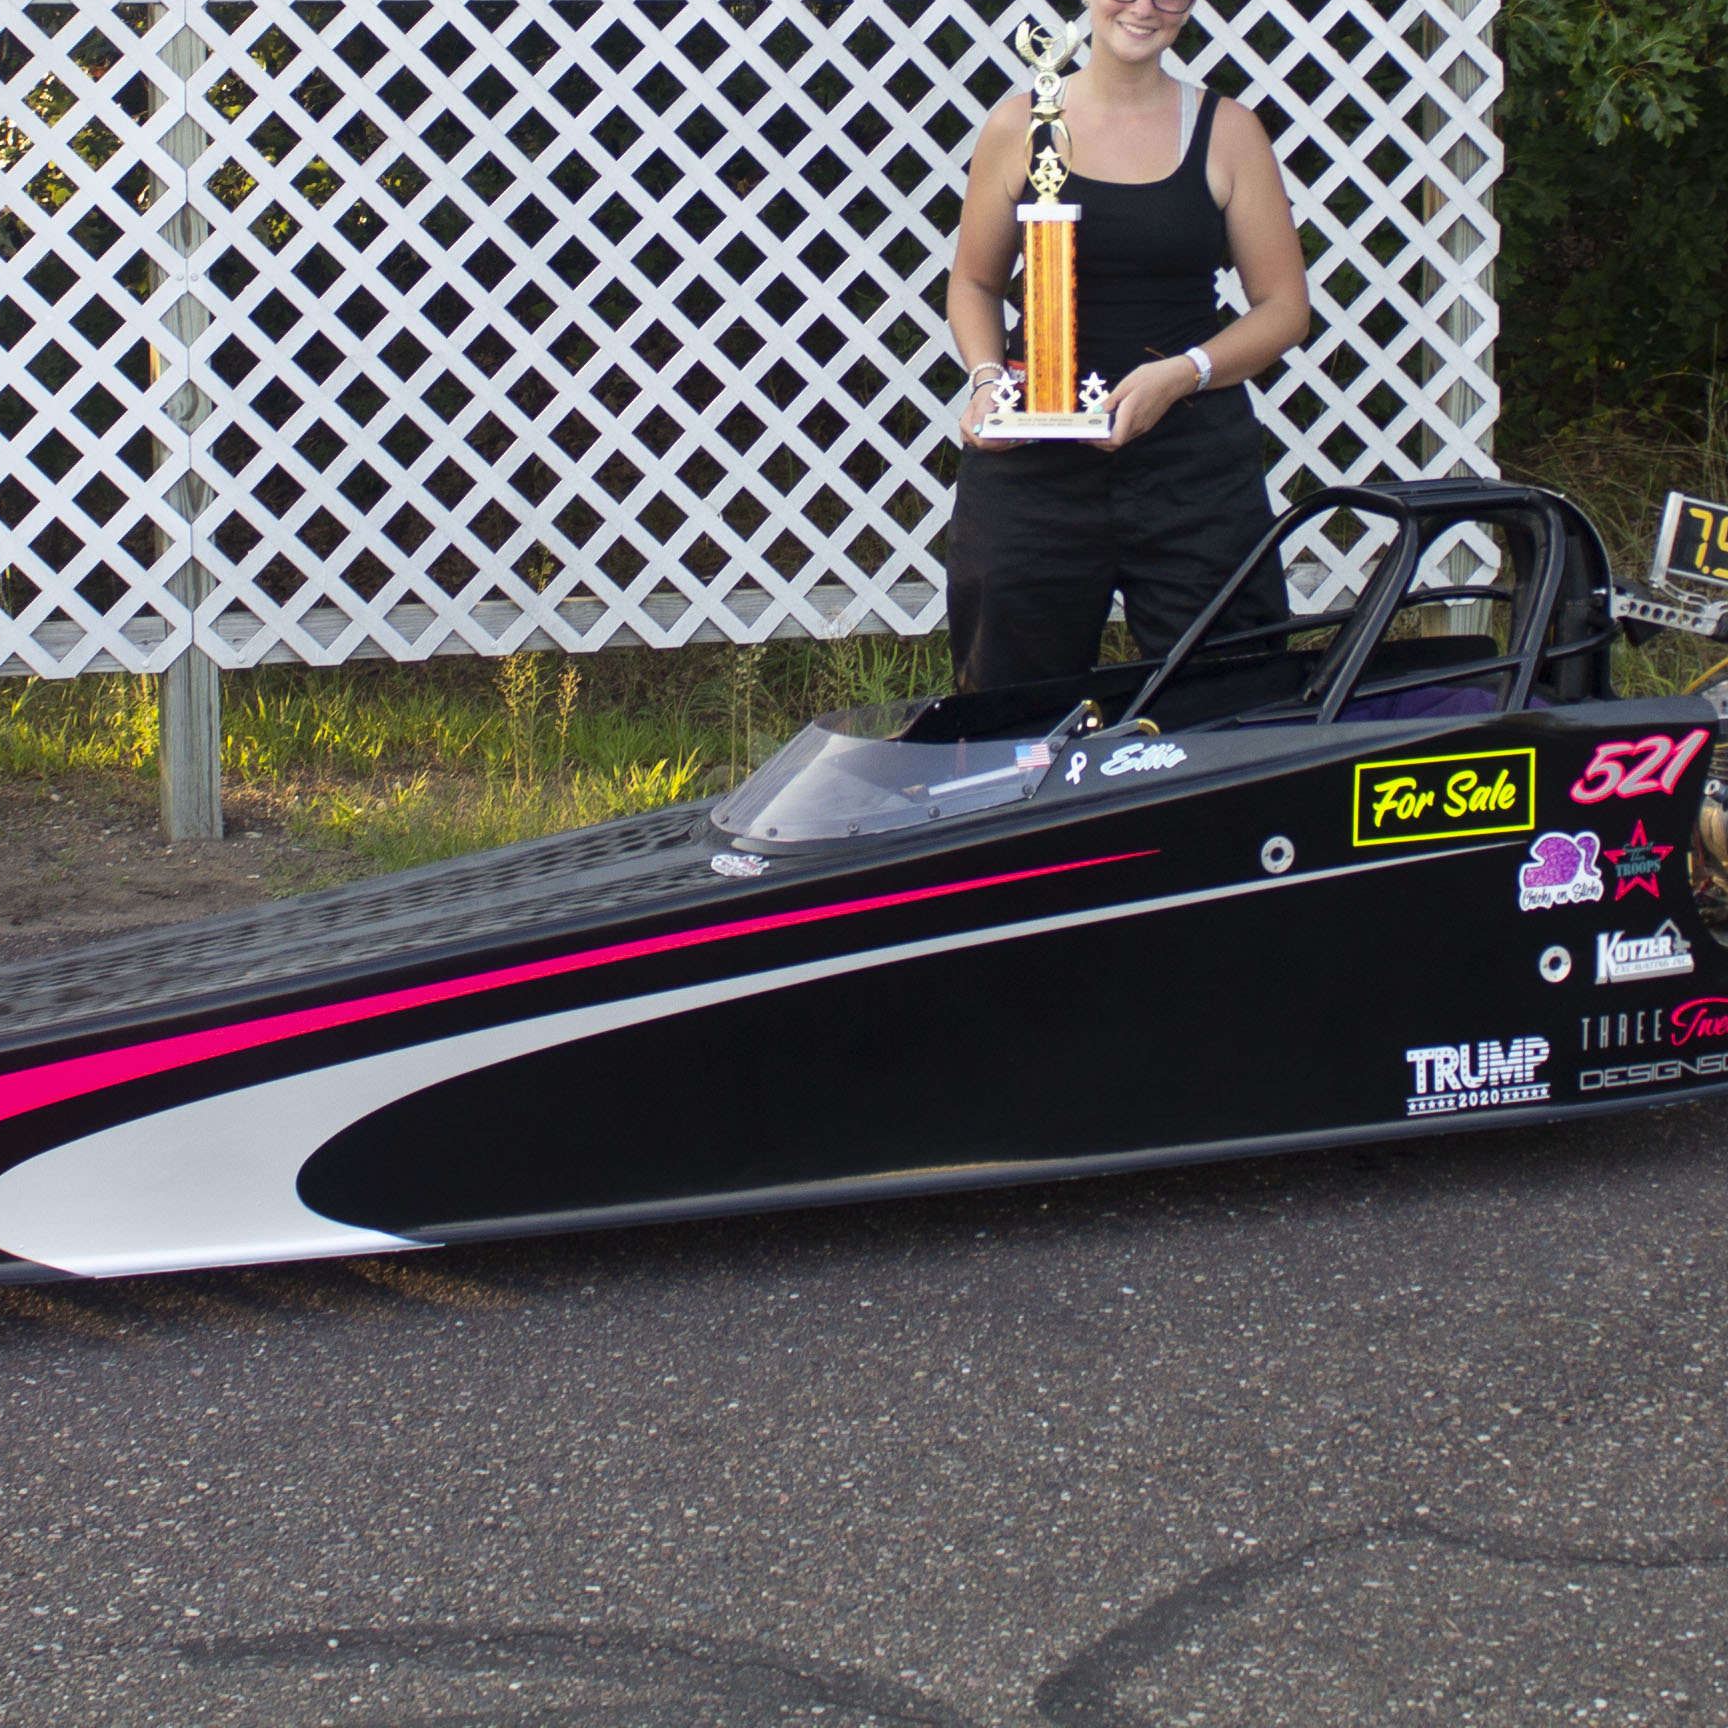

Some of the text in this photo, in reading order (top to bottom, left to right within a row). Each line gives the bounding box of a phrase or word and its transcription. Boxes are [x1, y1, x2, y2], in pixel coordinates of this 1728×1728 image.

[1571, 729, 1711, 804] 521
[1373, 769, 1517, 829] For Sale
[1616, 858, 1661, 877] TROOPS
[1556, 889, 1568, 901] on
[1595, 930, 1672, 983] KOTZER
[1581, 1008, 1664, 1051] THREE
[1406, 1036, 1550, 1094] TRUMP
[1458, 1090, 1500, 1108] 2020
